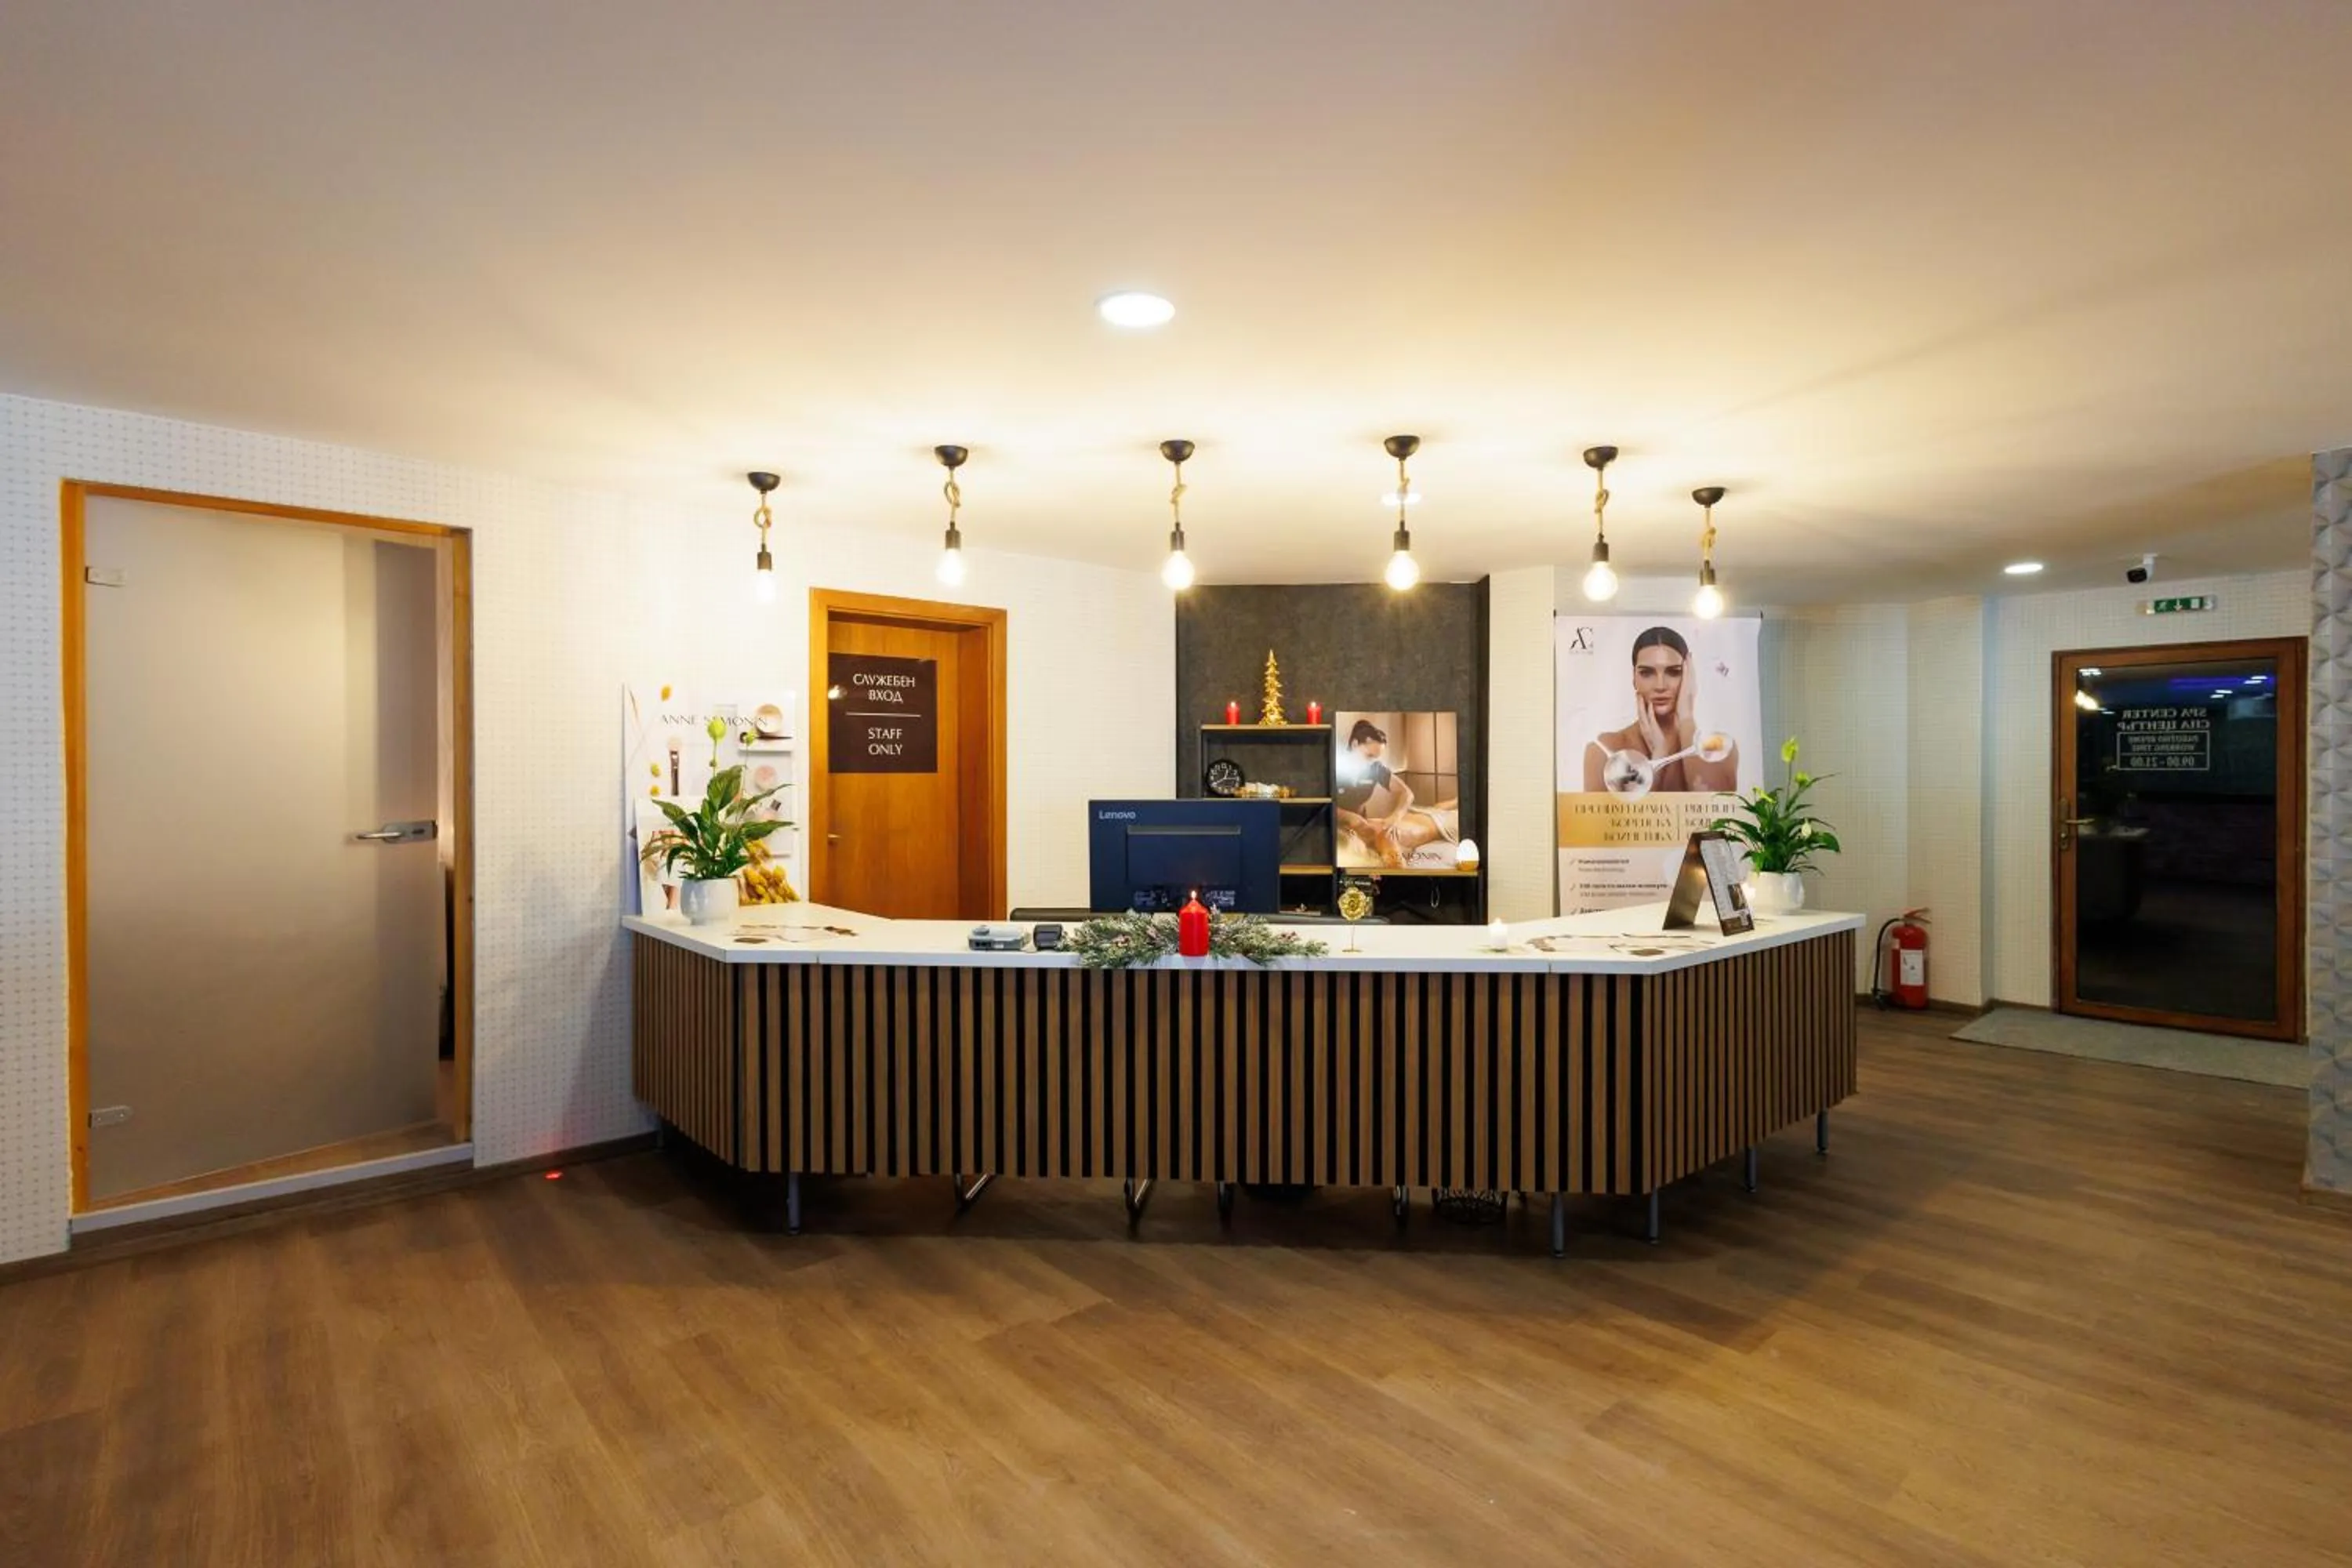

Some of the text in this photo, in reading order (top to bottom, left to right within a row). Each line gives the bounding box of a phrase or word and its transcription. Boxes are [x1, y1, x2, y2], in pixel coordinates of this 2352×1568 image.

[852, 673, 916, 688] СЛУЖЕБЕН
[868, 689, 903, 703] ВХОД
[662, 714, 696, 725] ANNE
[868, 728, 903, 739] STAFF
[868, 743, 903, 756] ONLY
[1098, 809, 1136, 819] Lenovo
